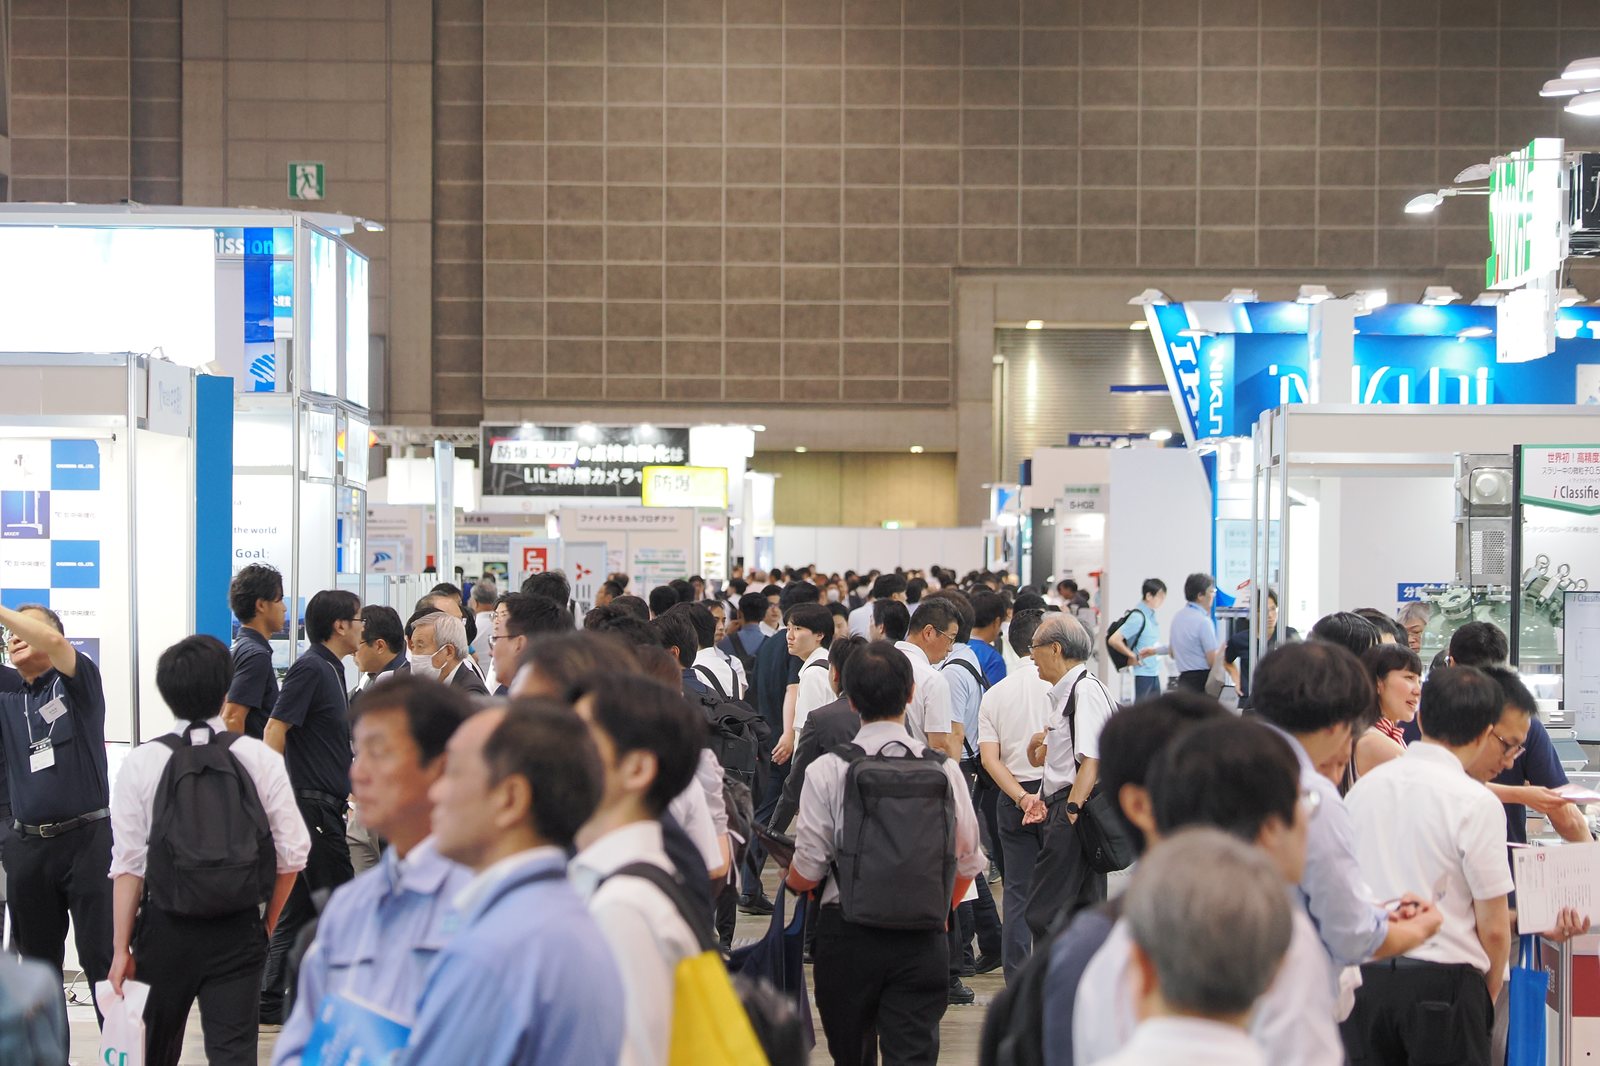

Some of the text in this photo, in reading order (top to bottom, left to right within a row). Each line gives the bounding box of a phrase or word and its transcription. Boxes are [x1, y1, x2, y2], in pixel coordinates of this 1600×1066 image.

[215, 231, 274, 255] ission
[1553, 485, 1558, 499] i
[233, 526, 277, 534] the world
